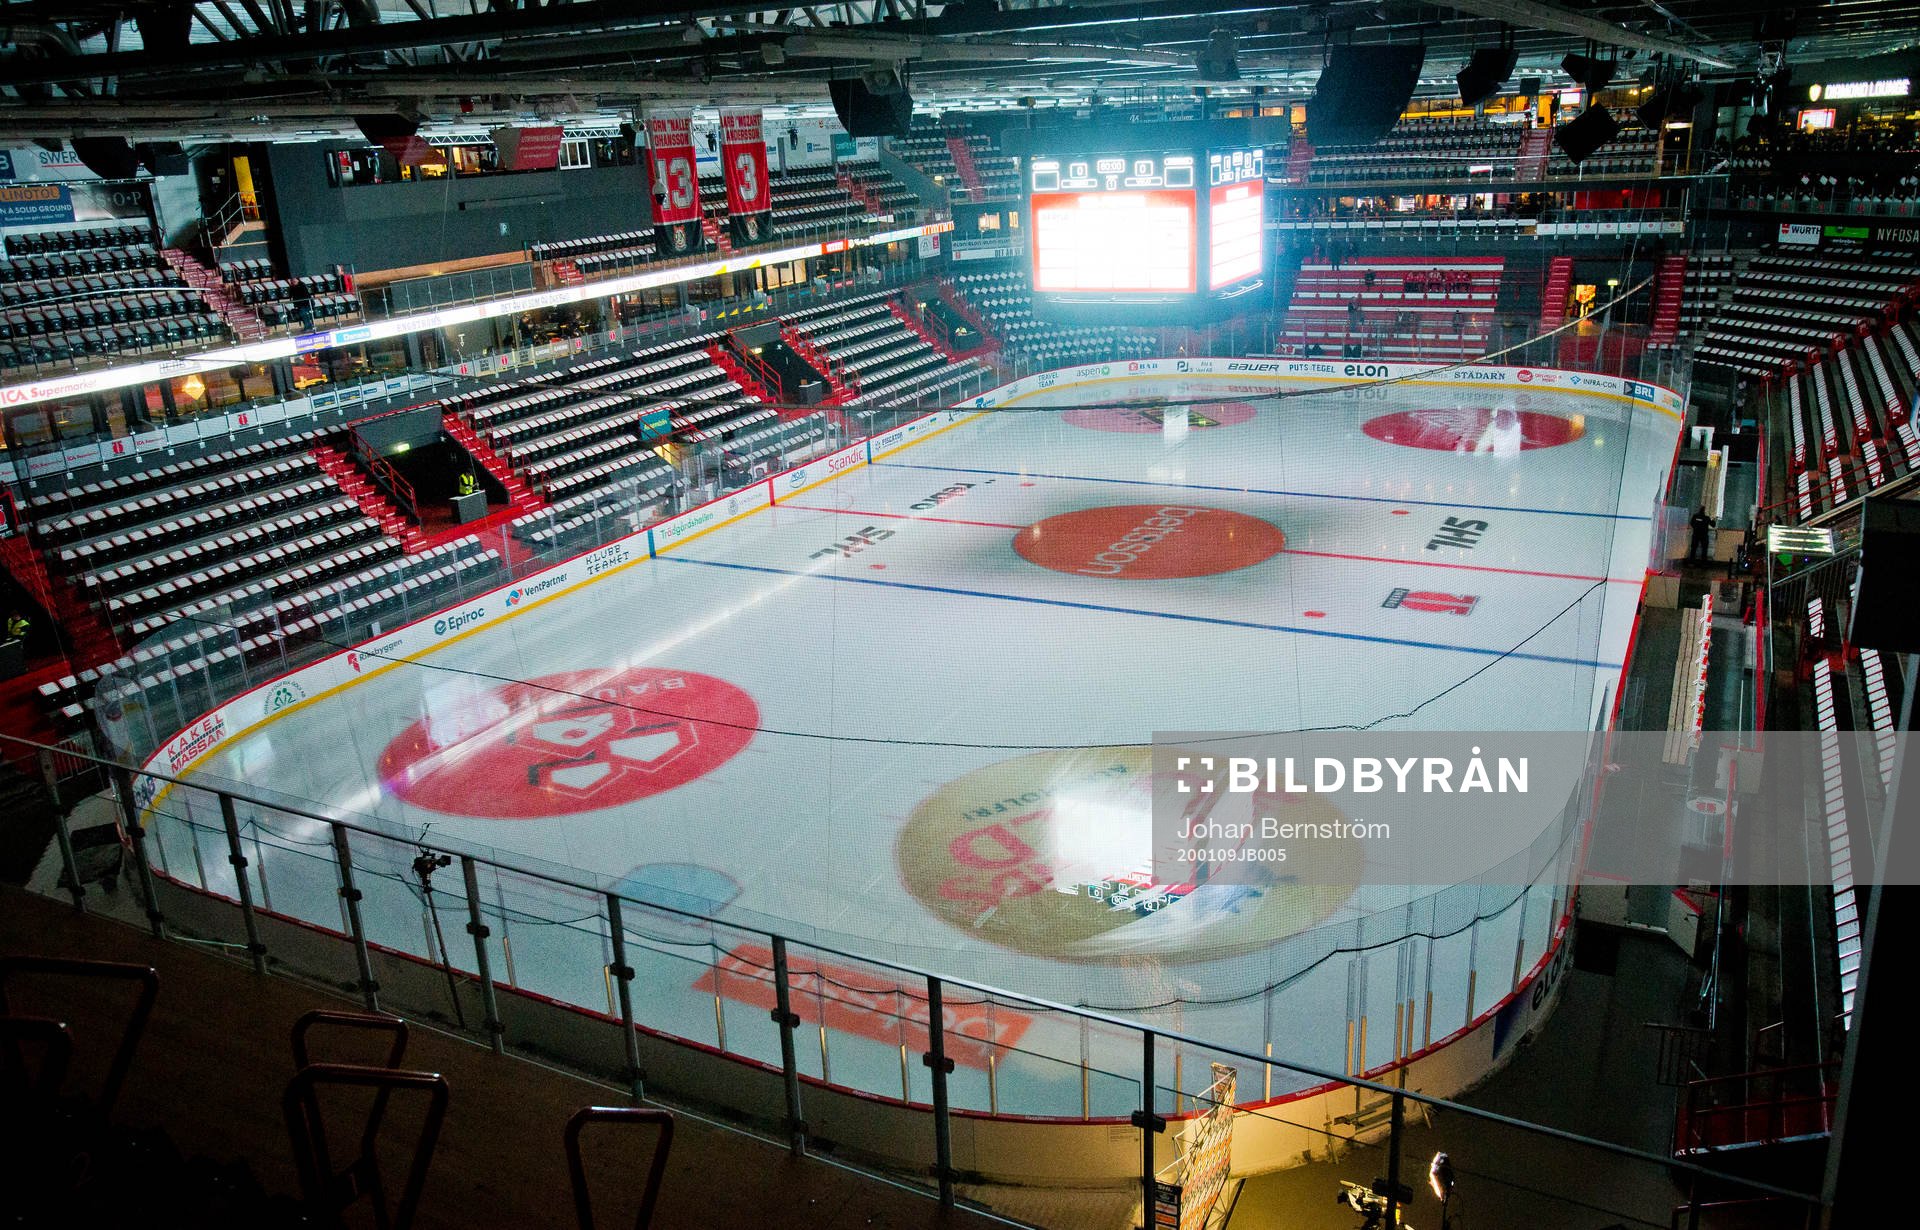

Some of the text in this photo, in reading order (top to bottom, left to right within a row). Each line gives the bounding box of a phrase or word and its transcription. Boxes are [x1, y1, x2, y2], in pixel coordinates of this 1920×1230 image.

[736, 153, 757, 202] 3
[15, 206, 36, 214] SOLID
[38, 203, 72, 213] GROUND
[1877, 227, 1919, 241] NYFOSA
[1289, 364, 1336, 373] PUTS TEGEL
[1634, 385, 1653, 398] BRL
[828, 447, 864, 473] Scandic
[524, 573, 568, 597] VentPartner
[448, 606, 485, 630] Epiroc
[167, 713, 224, 759] KAKEL
